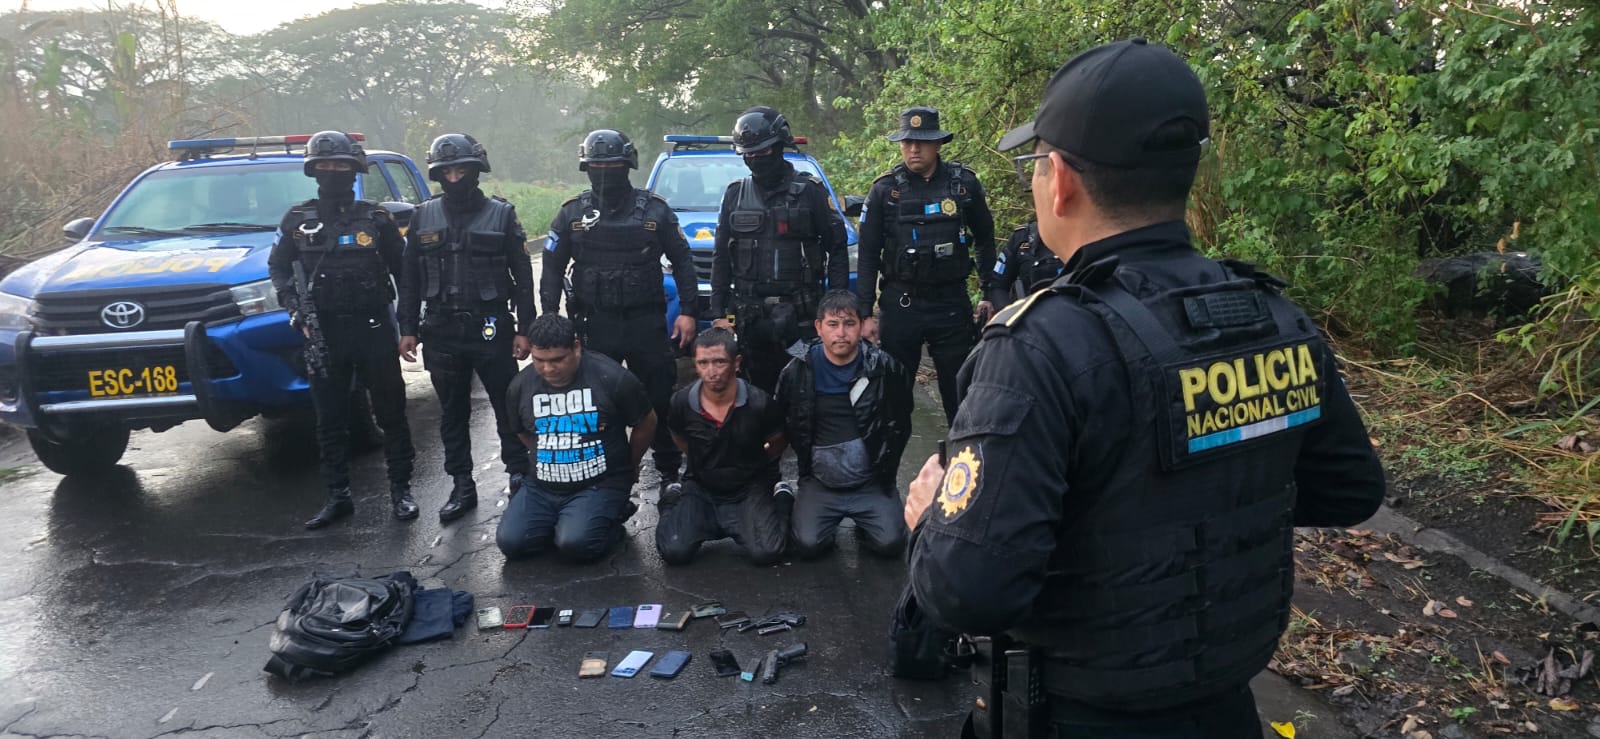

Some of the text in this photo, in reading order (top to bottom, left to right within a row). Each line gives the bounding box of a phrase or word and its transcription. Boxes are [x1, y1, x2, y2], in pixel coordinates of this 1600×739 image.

[88, 365, 177, 396] ESC-168
[1179, 344, 1318, 412] POLICIA
[532, 388, 597, 418] COOL
[1187, 385, 1320, 438] NACIONAL CIVIL
[534, 412, 598, 434] STORY
[536, 455, 607, 482] SANDWICH
[555, 449, 581, 463] MAKE
[583, 446, 596, 460] ME
[597, 444, 605, 455] A
